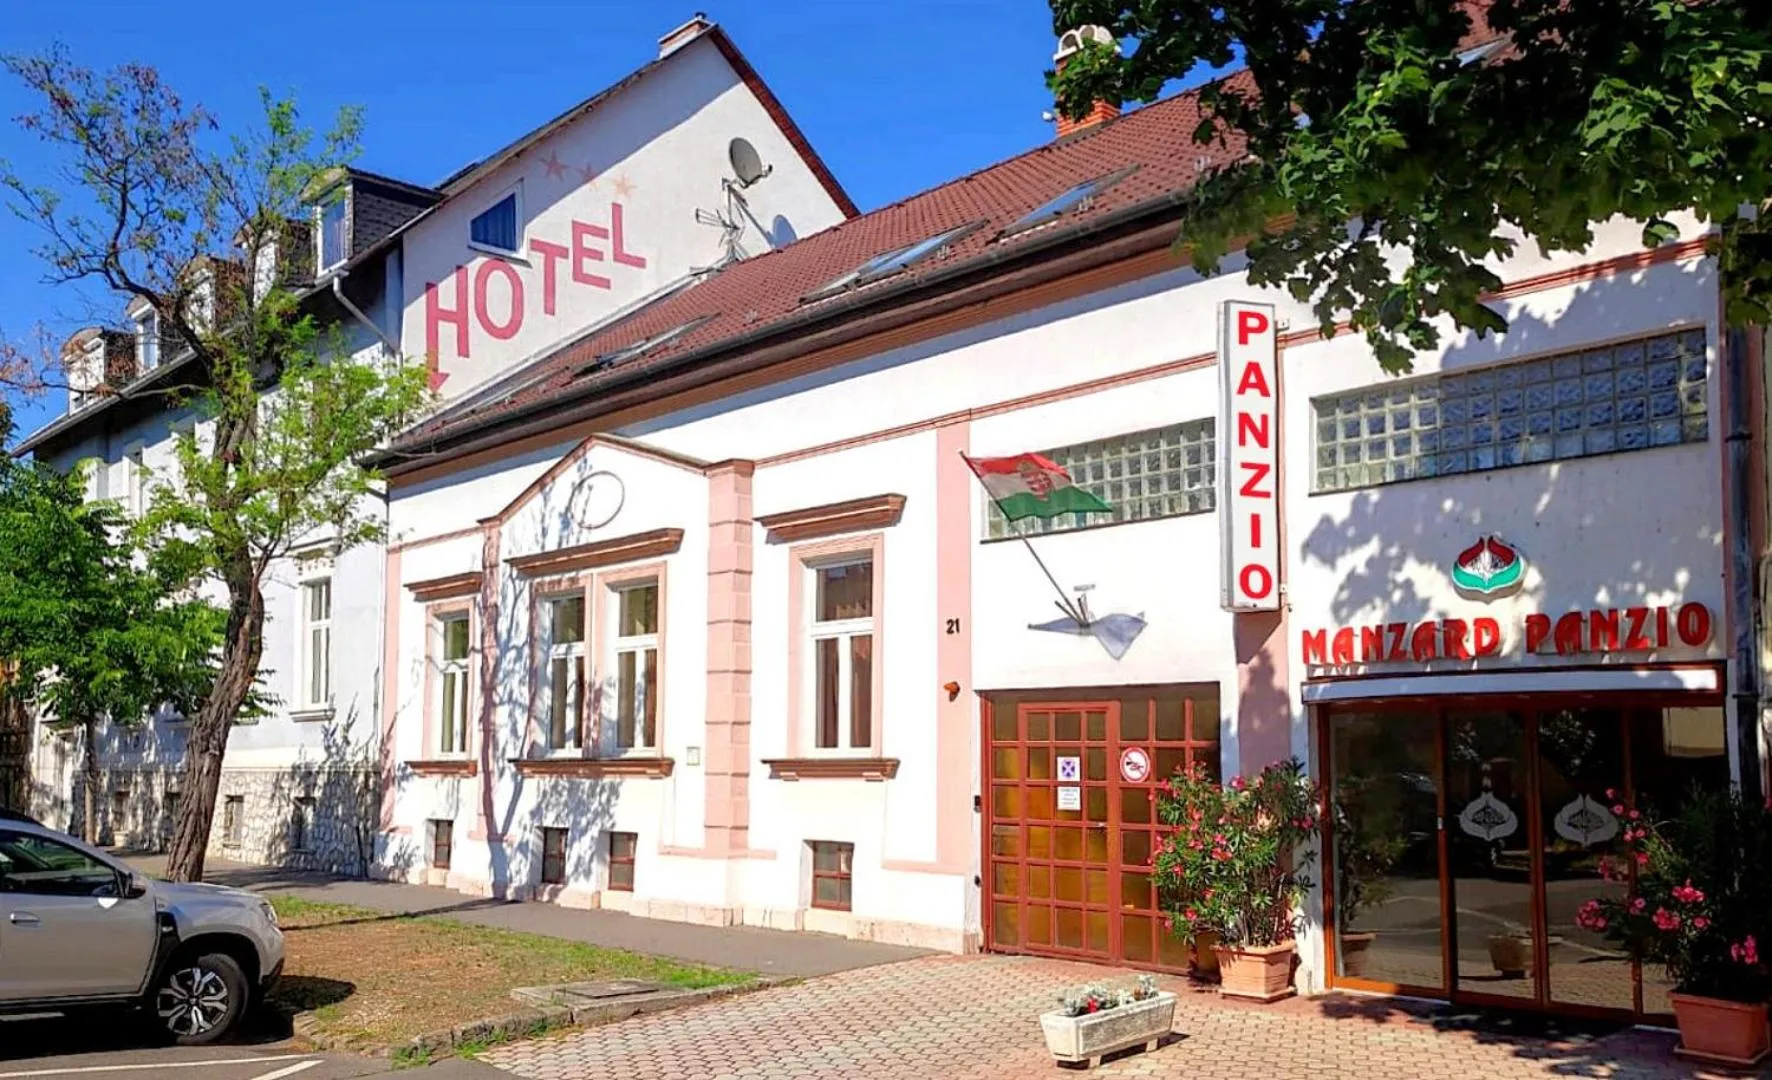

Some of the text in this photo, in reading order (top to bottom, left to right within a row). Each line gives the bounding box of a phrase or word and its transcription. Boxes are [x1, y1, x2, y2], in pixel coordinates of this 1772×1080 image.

[426, 202, 646, 362] HOTEL
[1236, 310, 1273, 600] PANZIO
[946, 618, 960, 635] 21
[1302, 602, 1712, 665] MANZARD PANZIO
